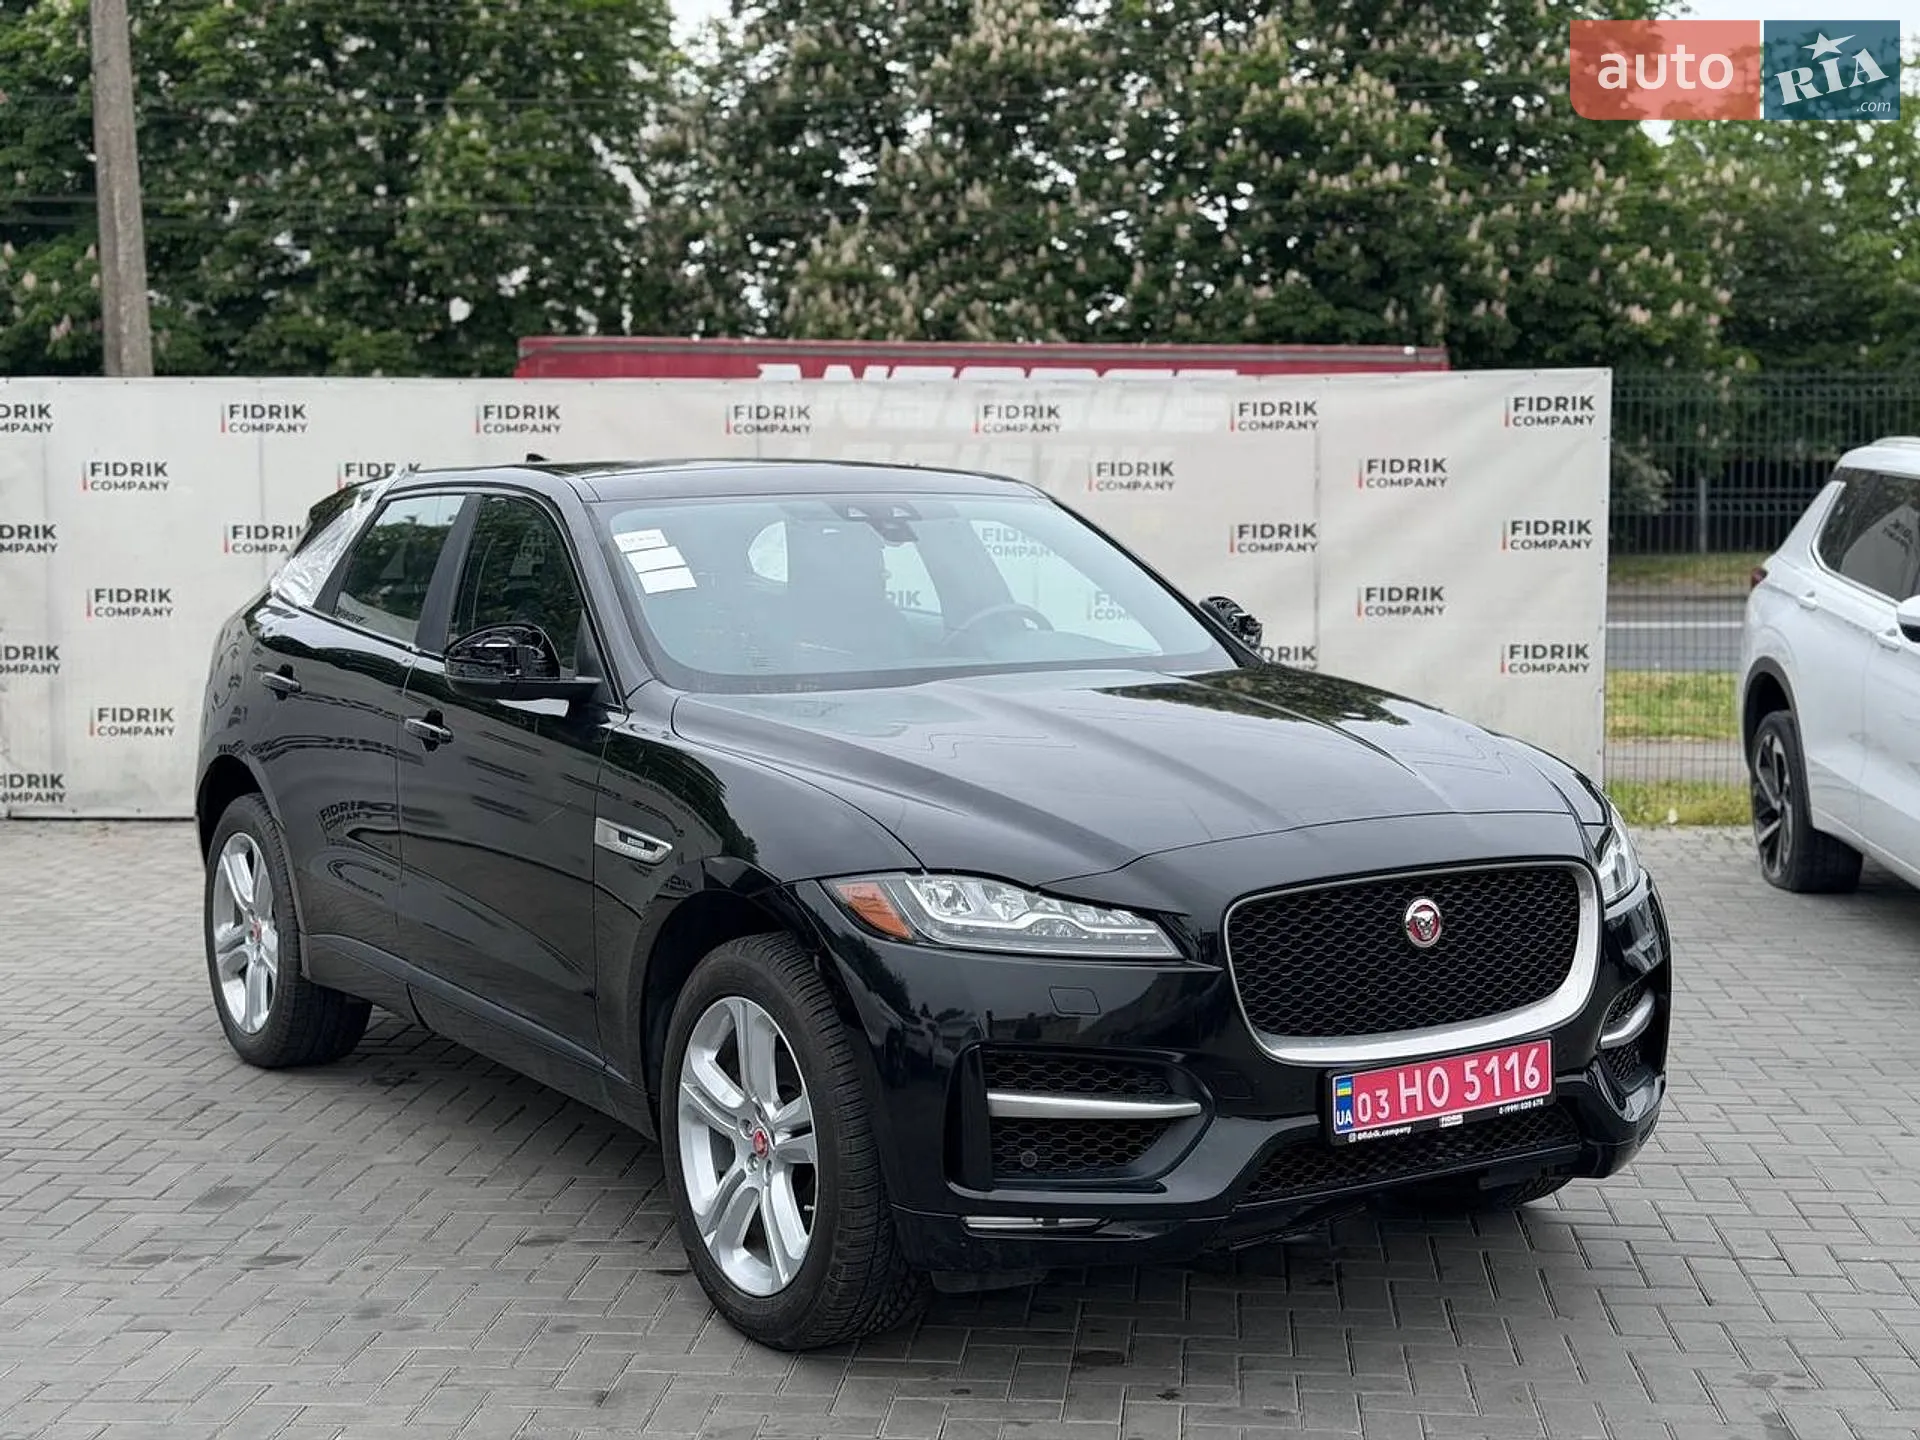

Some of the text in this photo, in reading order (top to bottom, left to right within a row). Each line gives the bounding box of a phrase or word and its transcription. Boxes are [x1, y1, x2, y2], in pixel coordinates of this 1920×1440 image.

[1238, 401, 1318, 416] FIDRIK
[1513, 396, 1595, 412] FIDRIK
[229, 404, 307, 419] FIDRIK
[483, 405, 561, 419] FIDRIK
[733, 405, 811, 420] FIDRIK
[983, 405, 1060, 419] FIDRIK
[228, 423, 309, 433] COMPANY
[1237, 420, 1319, 431] COMPANY
[1512, 415, 1596, 427] COMPANY
[482, 424, 561, 434] COMPANY
[733, 424, 811, 434] COMPANY
[983, 424, 1061, 433] COMPANY
[90, 462, 169, 477] FIDRIK
[1096, 462, 1174, 477] FIDRIK
[1366, 458, 1448, 474] FIDRIK
[90, 481, 169, 491] COMPANY
[1095, 481, 1175, 491] COMPANY
[1366, 478, 1448, 488] COMPANY
[1237, 523, 1317, 539] FIDRIK
[1510, 520, 1592, 535] FIDRIK
[231, 543, 289, 553] COMPA
[1237, 543, 1318, 553] COMPANY
[1509, 539, 1593, 550] COMPANY
[94, 588, 173, 603] FIDRIK
[1365, 586, 1445, 602] FIDRIK
[94, 607, 174, 617] COMPANY
[1364, 606, 1445, 616] COMPANY
[1509, 644, 1590, 659] FIDRIK
[1508, 663, 1590, 674] COMPANY
[97, 708, 175, 723] FIDRIK
[96, 726, 175, 736] COMPANY
[1356, 1047, 1542, 1124] 03 HO 5116
[1336, 1109, 1353, 1127] UA
